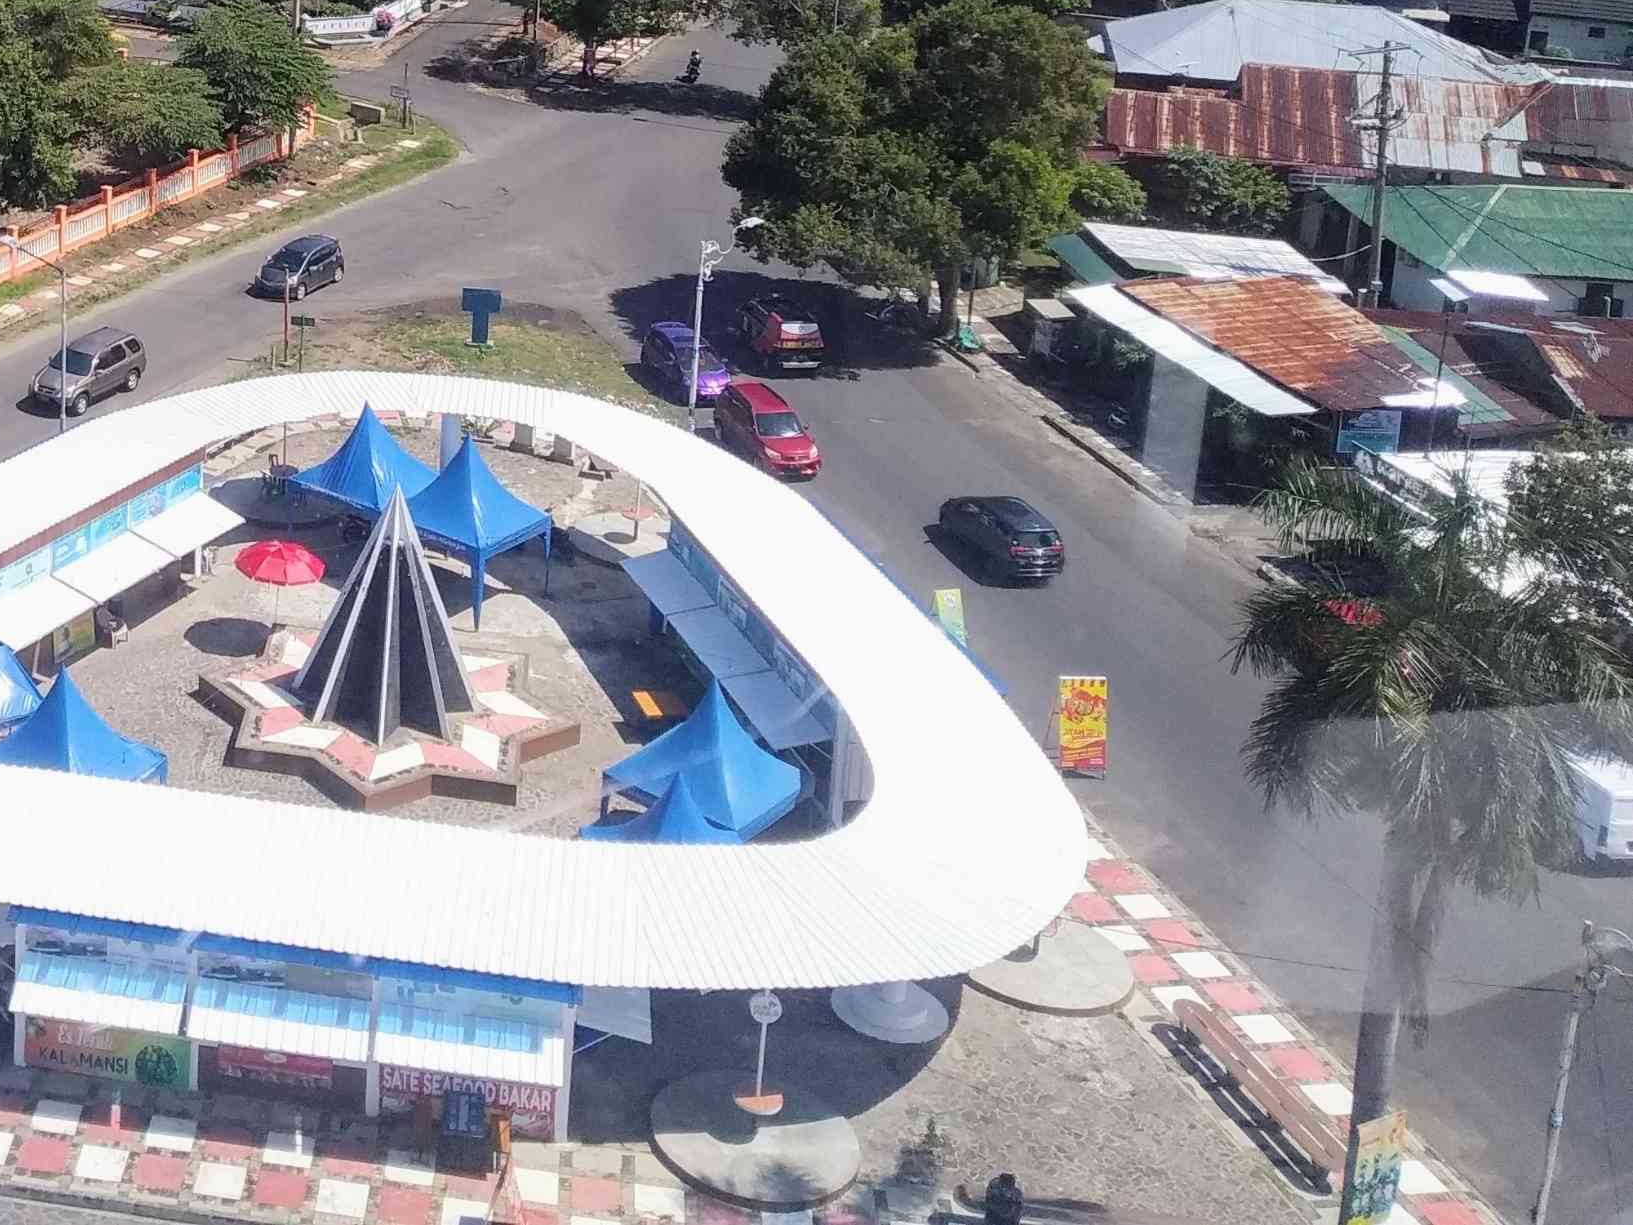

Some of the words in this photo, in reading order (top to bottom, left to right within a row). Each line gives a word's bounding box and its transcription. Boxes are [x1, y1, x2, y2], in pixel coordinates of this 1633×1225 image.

[39, 1046, 129, 1074] KALAMANSI
[383, 1067, 419, 1093] SATE
[499, 1084, 552, 1111] BAKAR
